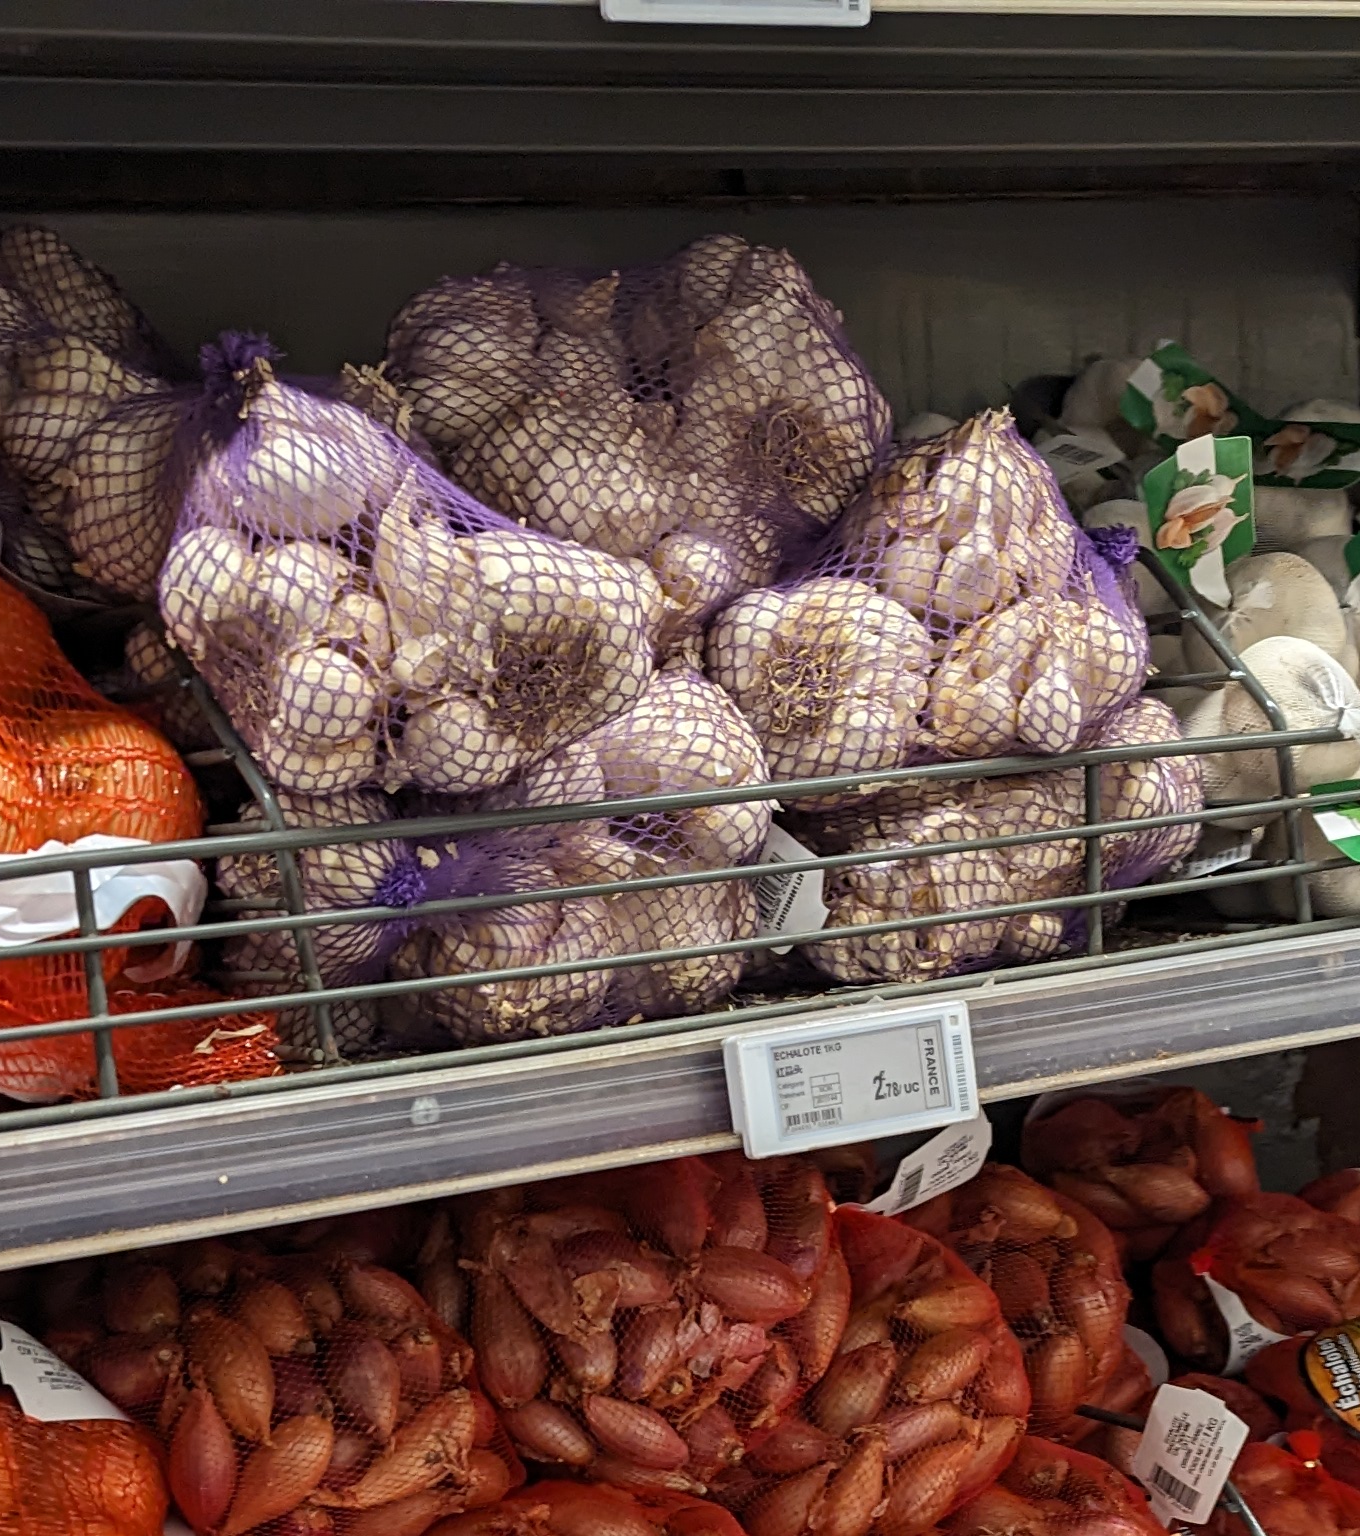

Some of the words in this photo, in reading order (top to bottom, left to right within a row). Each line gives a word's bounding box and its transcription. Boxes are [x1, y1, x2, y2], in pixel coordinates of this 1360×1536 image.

[773, 1045, 822, 1062] ECHALOTE
[922, 1038, 941, 1096] FRANCE
[903, 1081, 920, 1094] UC
[1205, 1417, 1219, 1434] KG
